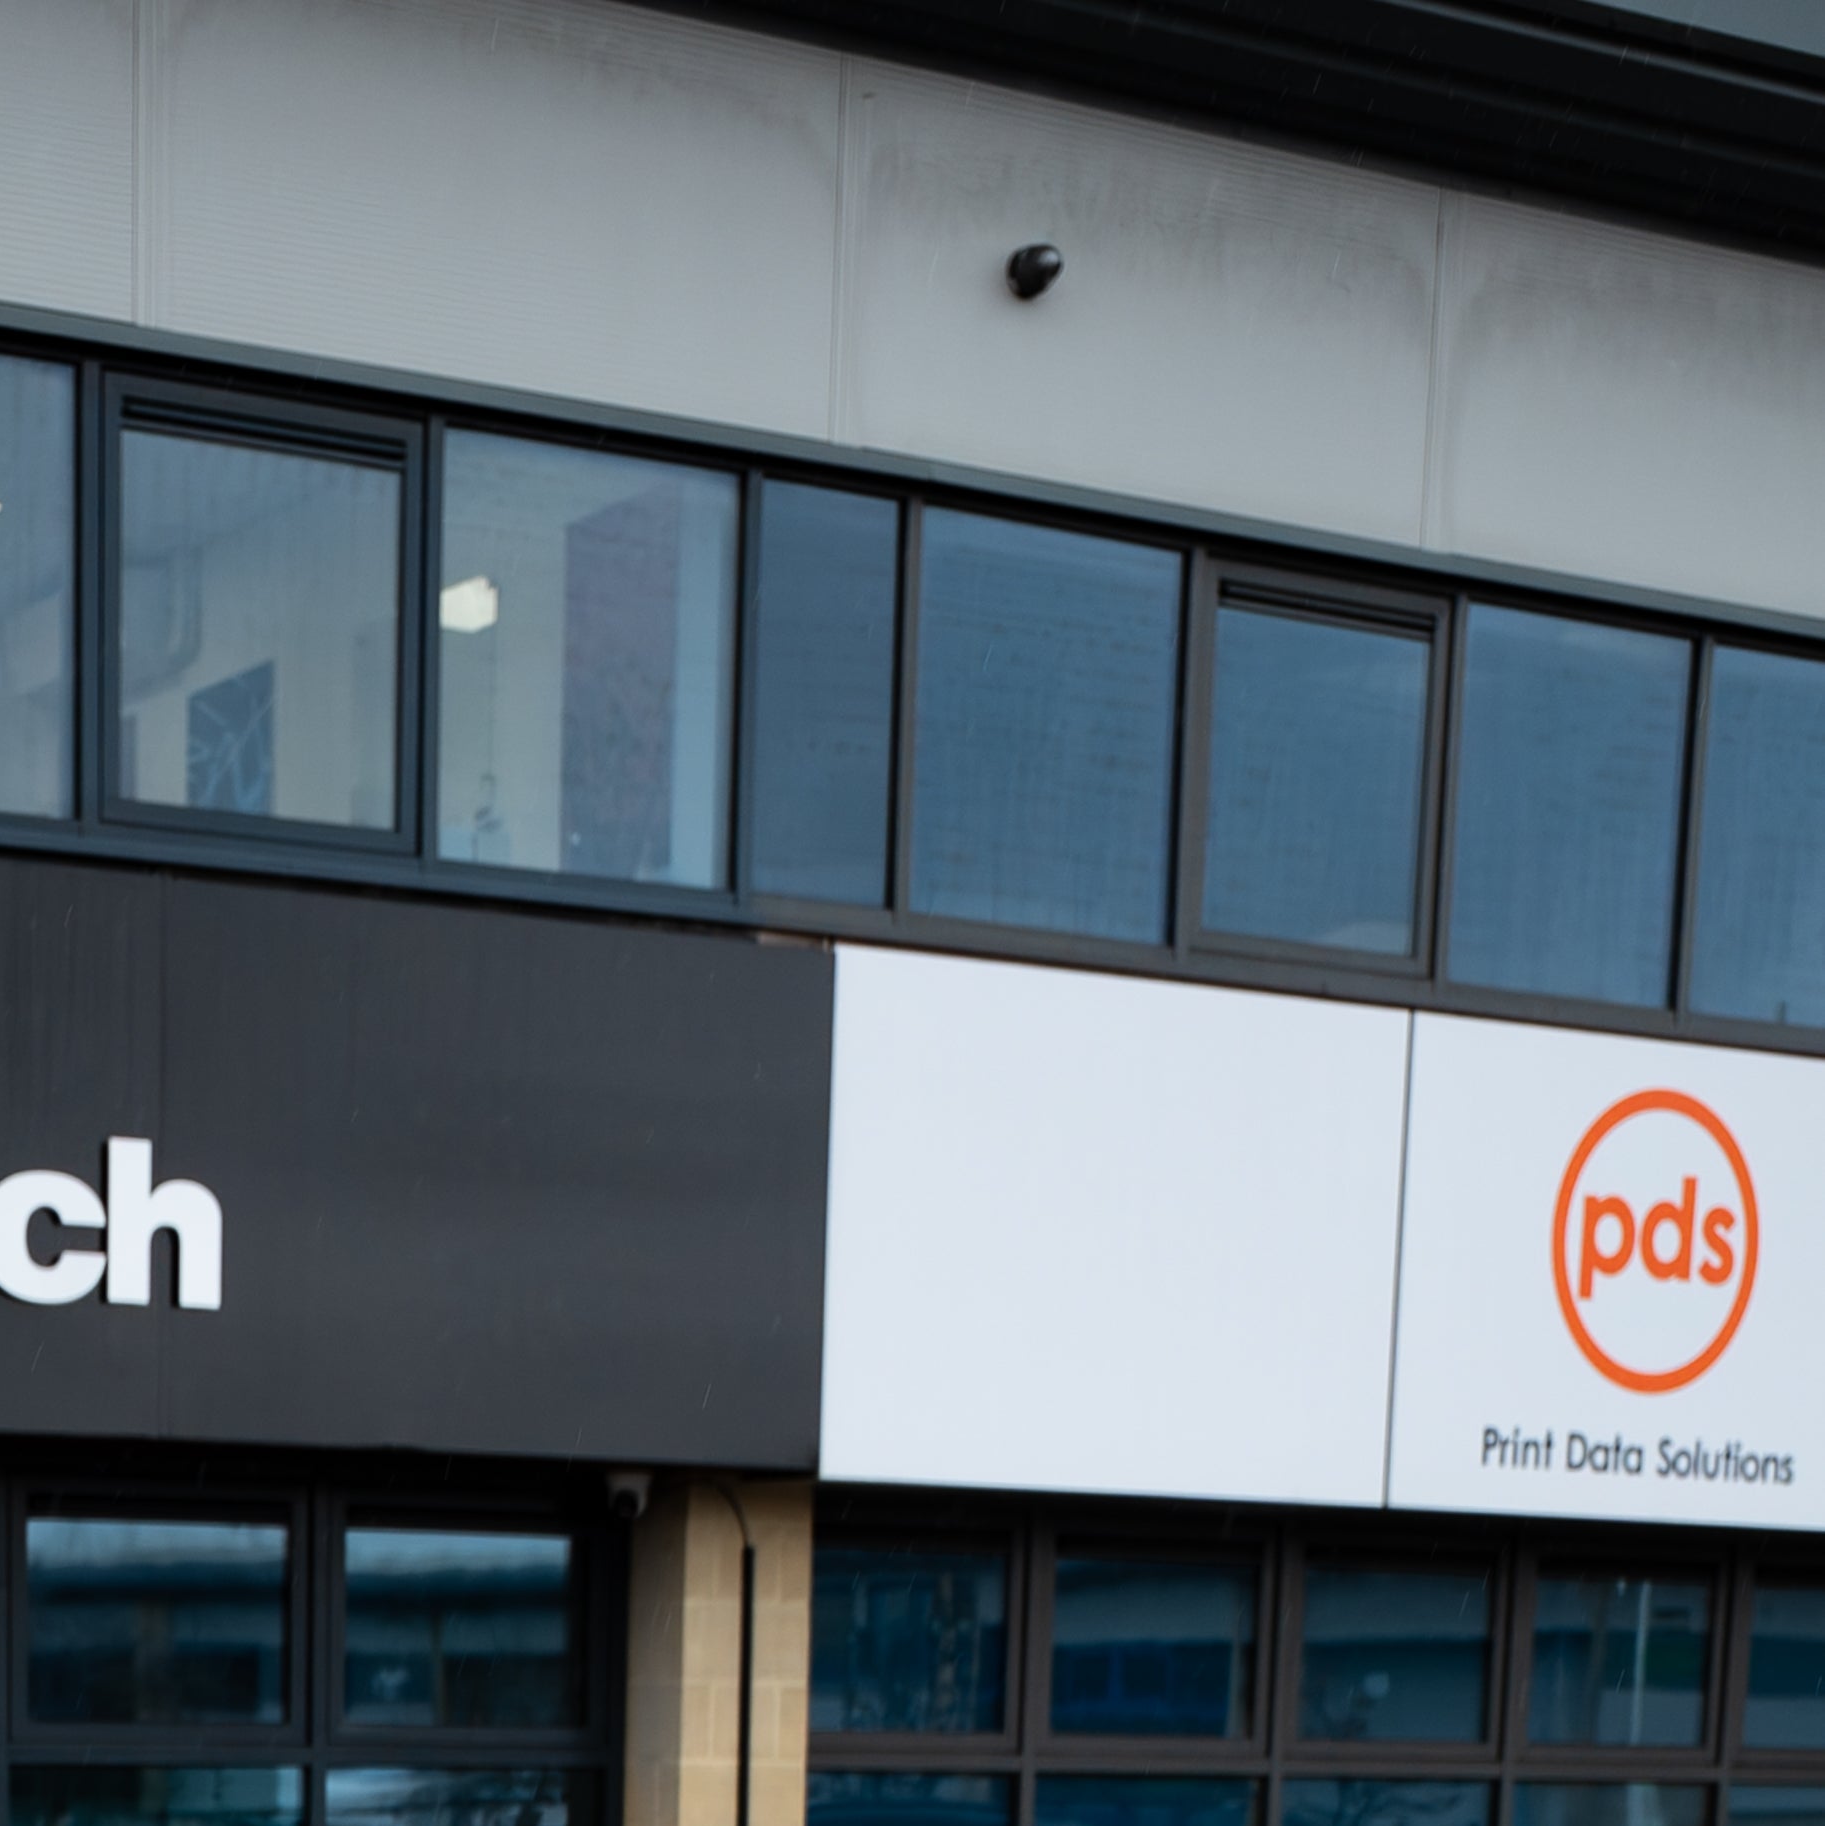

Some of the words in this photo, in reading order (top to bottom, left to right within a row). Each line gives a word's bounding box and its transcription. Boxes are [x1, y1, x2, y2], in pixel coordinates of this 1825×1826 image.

[1579, 1175, 1736, 1299] pds
[1481, 1427, 1554, 1469] Print
[1567, 1432, 1644, 1475] Data
[1657, 1438, 1795, 1484] Solutions
